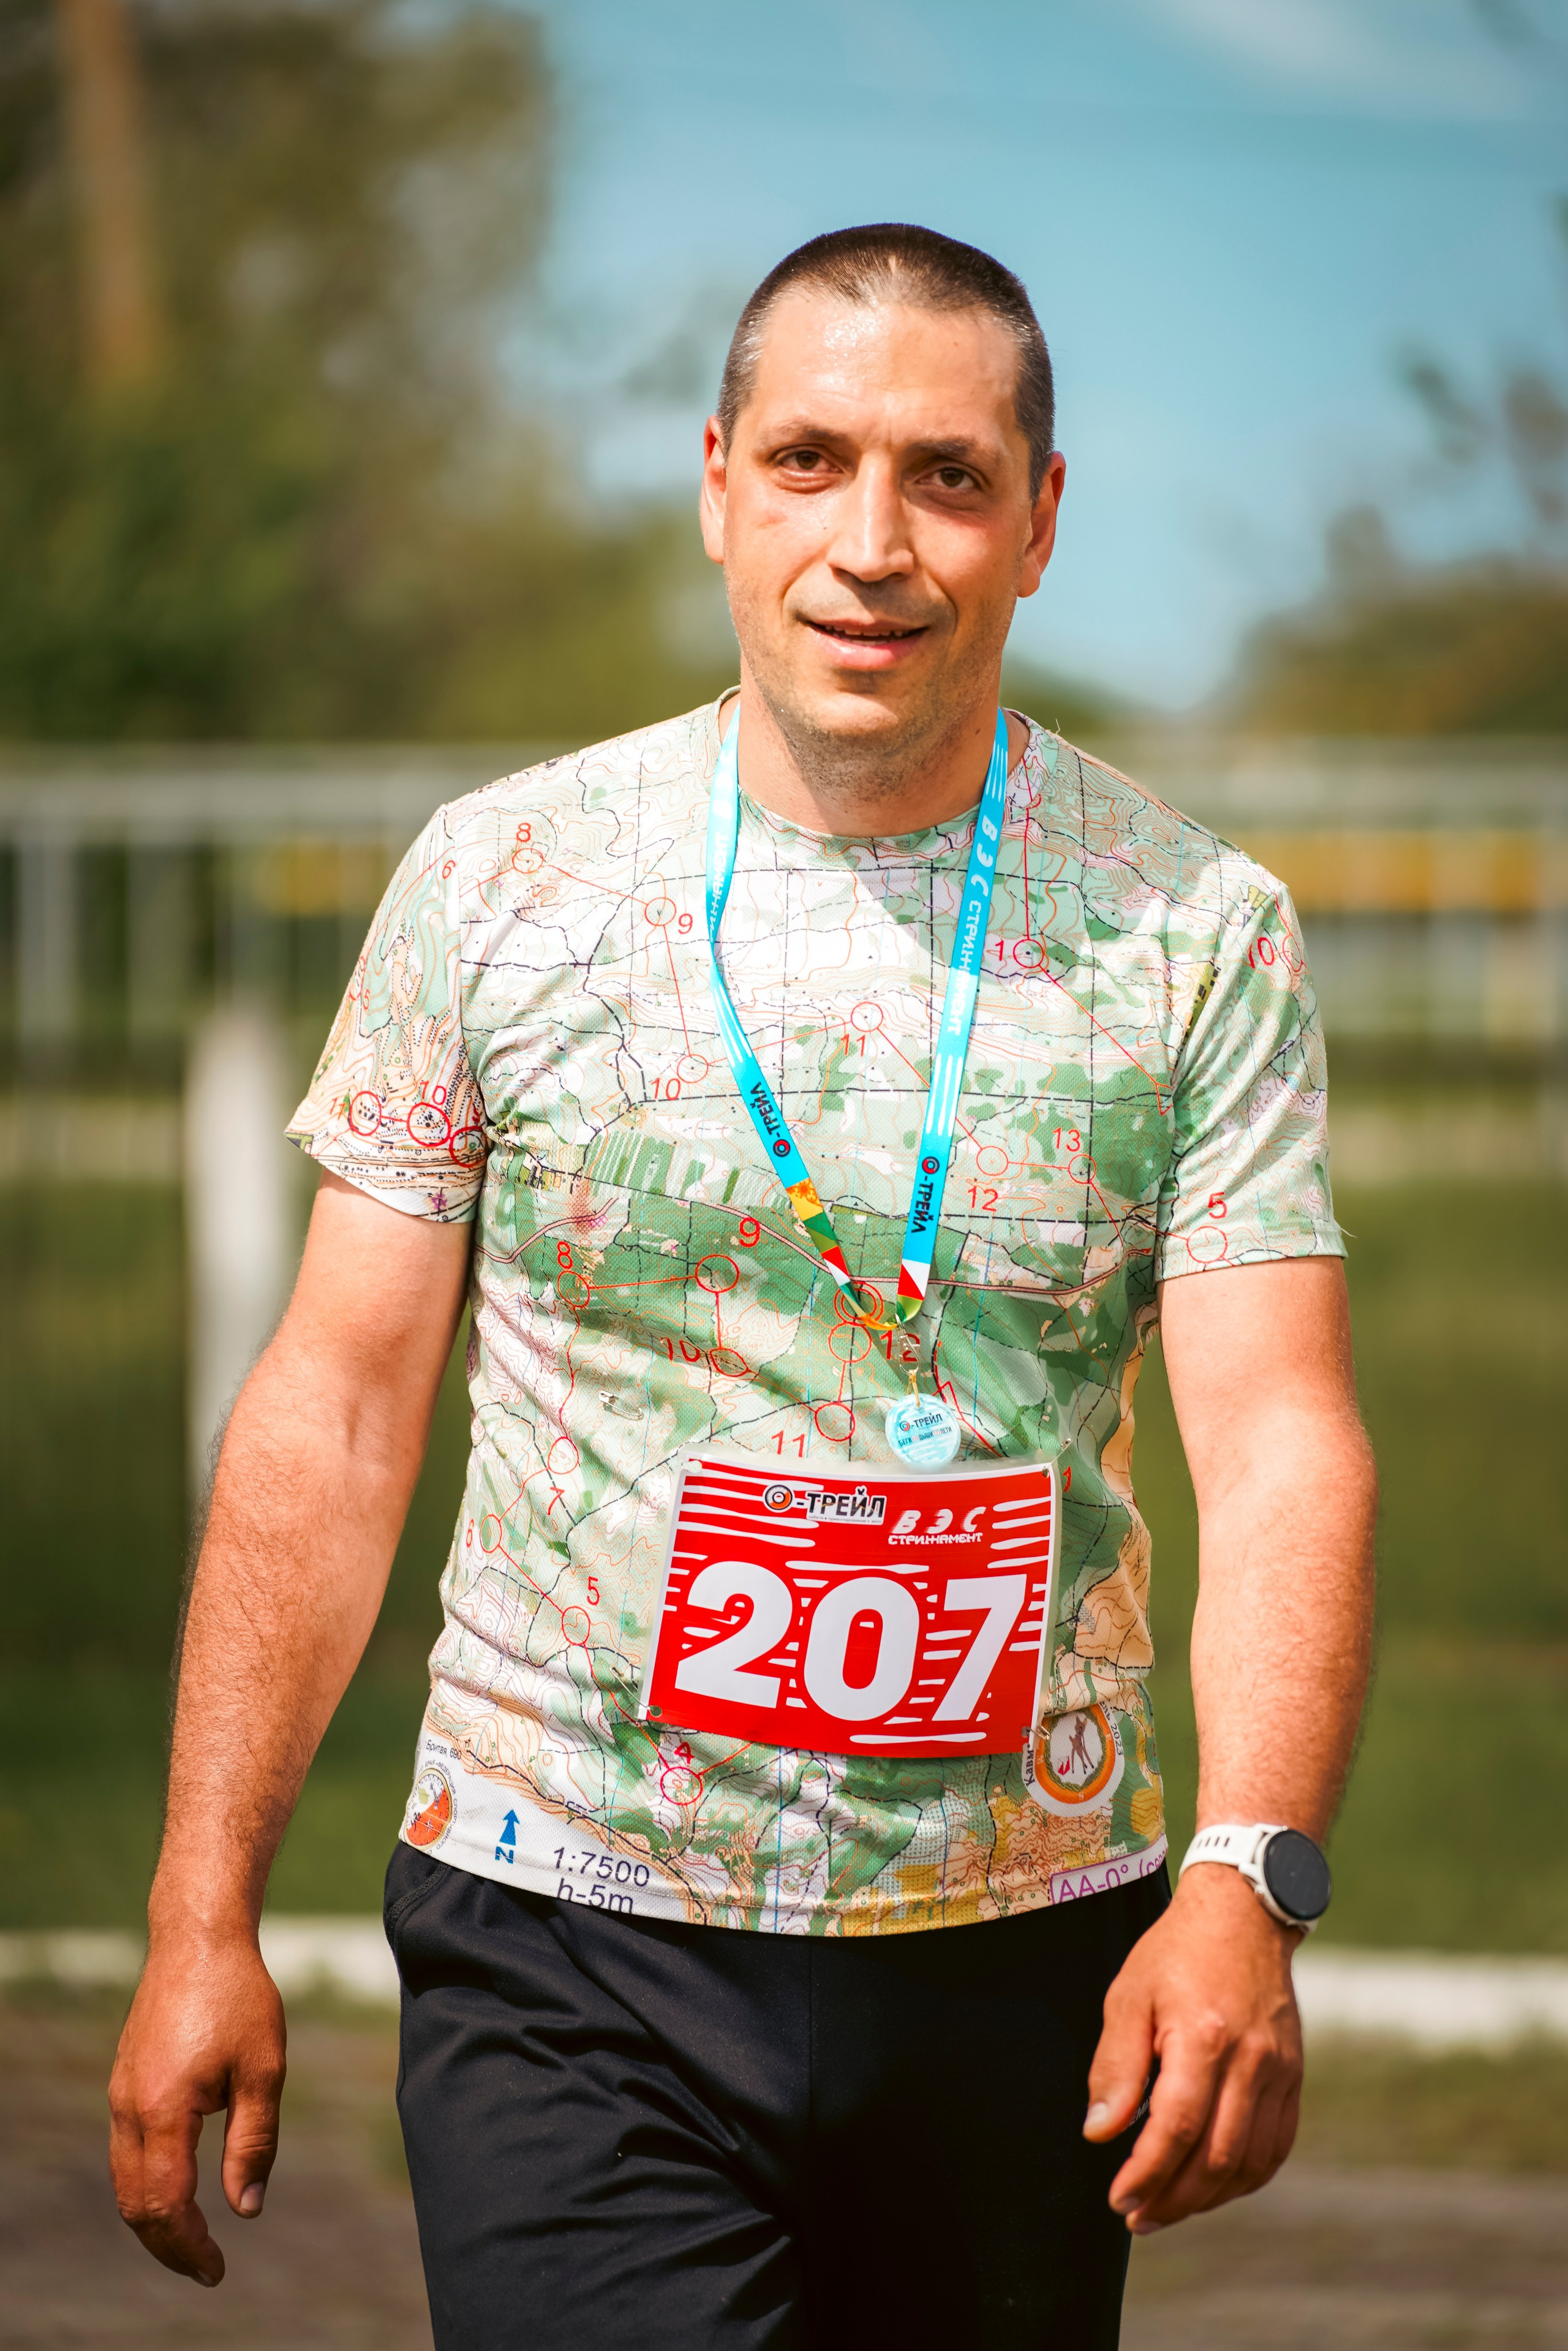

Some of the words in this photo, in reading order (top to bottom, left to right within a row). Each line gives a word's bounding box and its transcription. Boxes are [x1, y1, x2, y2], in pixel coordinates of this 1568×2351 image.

[516, 822, 532, 845] 8
[441, 859, 456, 880] 6
[677, 913, 693, 935] 9
[995, 940, 1005, 962] 1
[840, 1033, 867, 1057] 11
[420, 1081, 447, 1105] 10
[649, 1077, 681, 1101] 10
[1050, 1127, 1081, 1152] 13
[967, 1185, 999, 1212] 12
[1208, 1191, 1227, 1219] 5
[738, 1217, 760, 1247] 9
[556, 1241, 573, 1269] 8
[659, 1336, 700, 1363] 10
[771, 1430, 805, 1458] 11
[548, 1487, 565, 1516] 7
[888, 1532, 983, 1545] СТРИЖАМЕНТ
[586, 1576, 600, 1606] 5
[674, 1561, 1027, 1722] 207
[1110, 1723, 1123, 1756] 2023
[450, 1748, 462, 1760] 690
[674, 1741, 695, 1765] 4
[495, 1846, 514, 1864] N
[554, 1847, 650, 1887] 1:7500
[557, 1877, 633, 1914] h-5m
